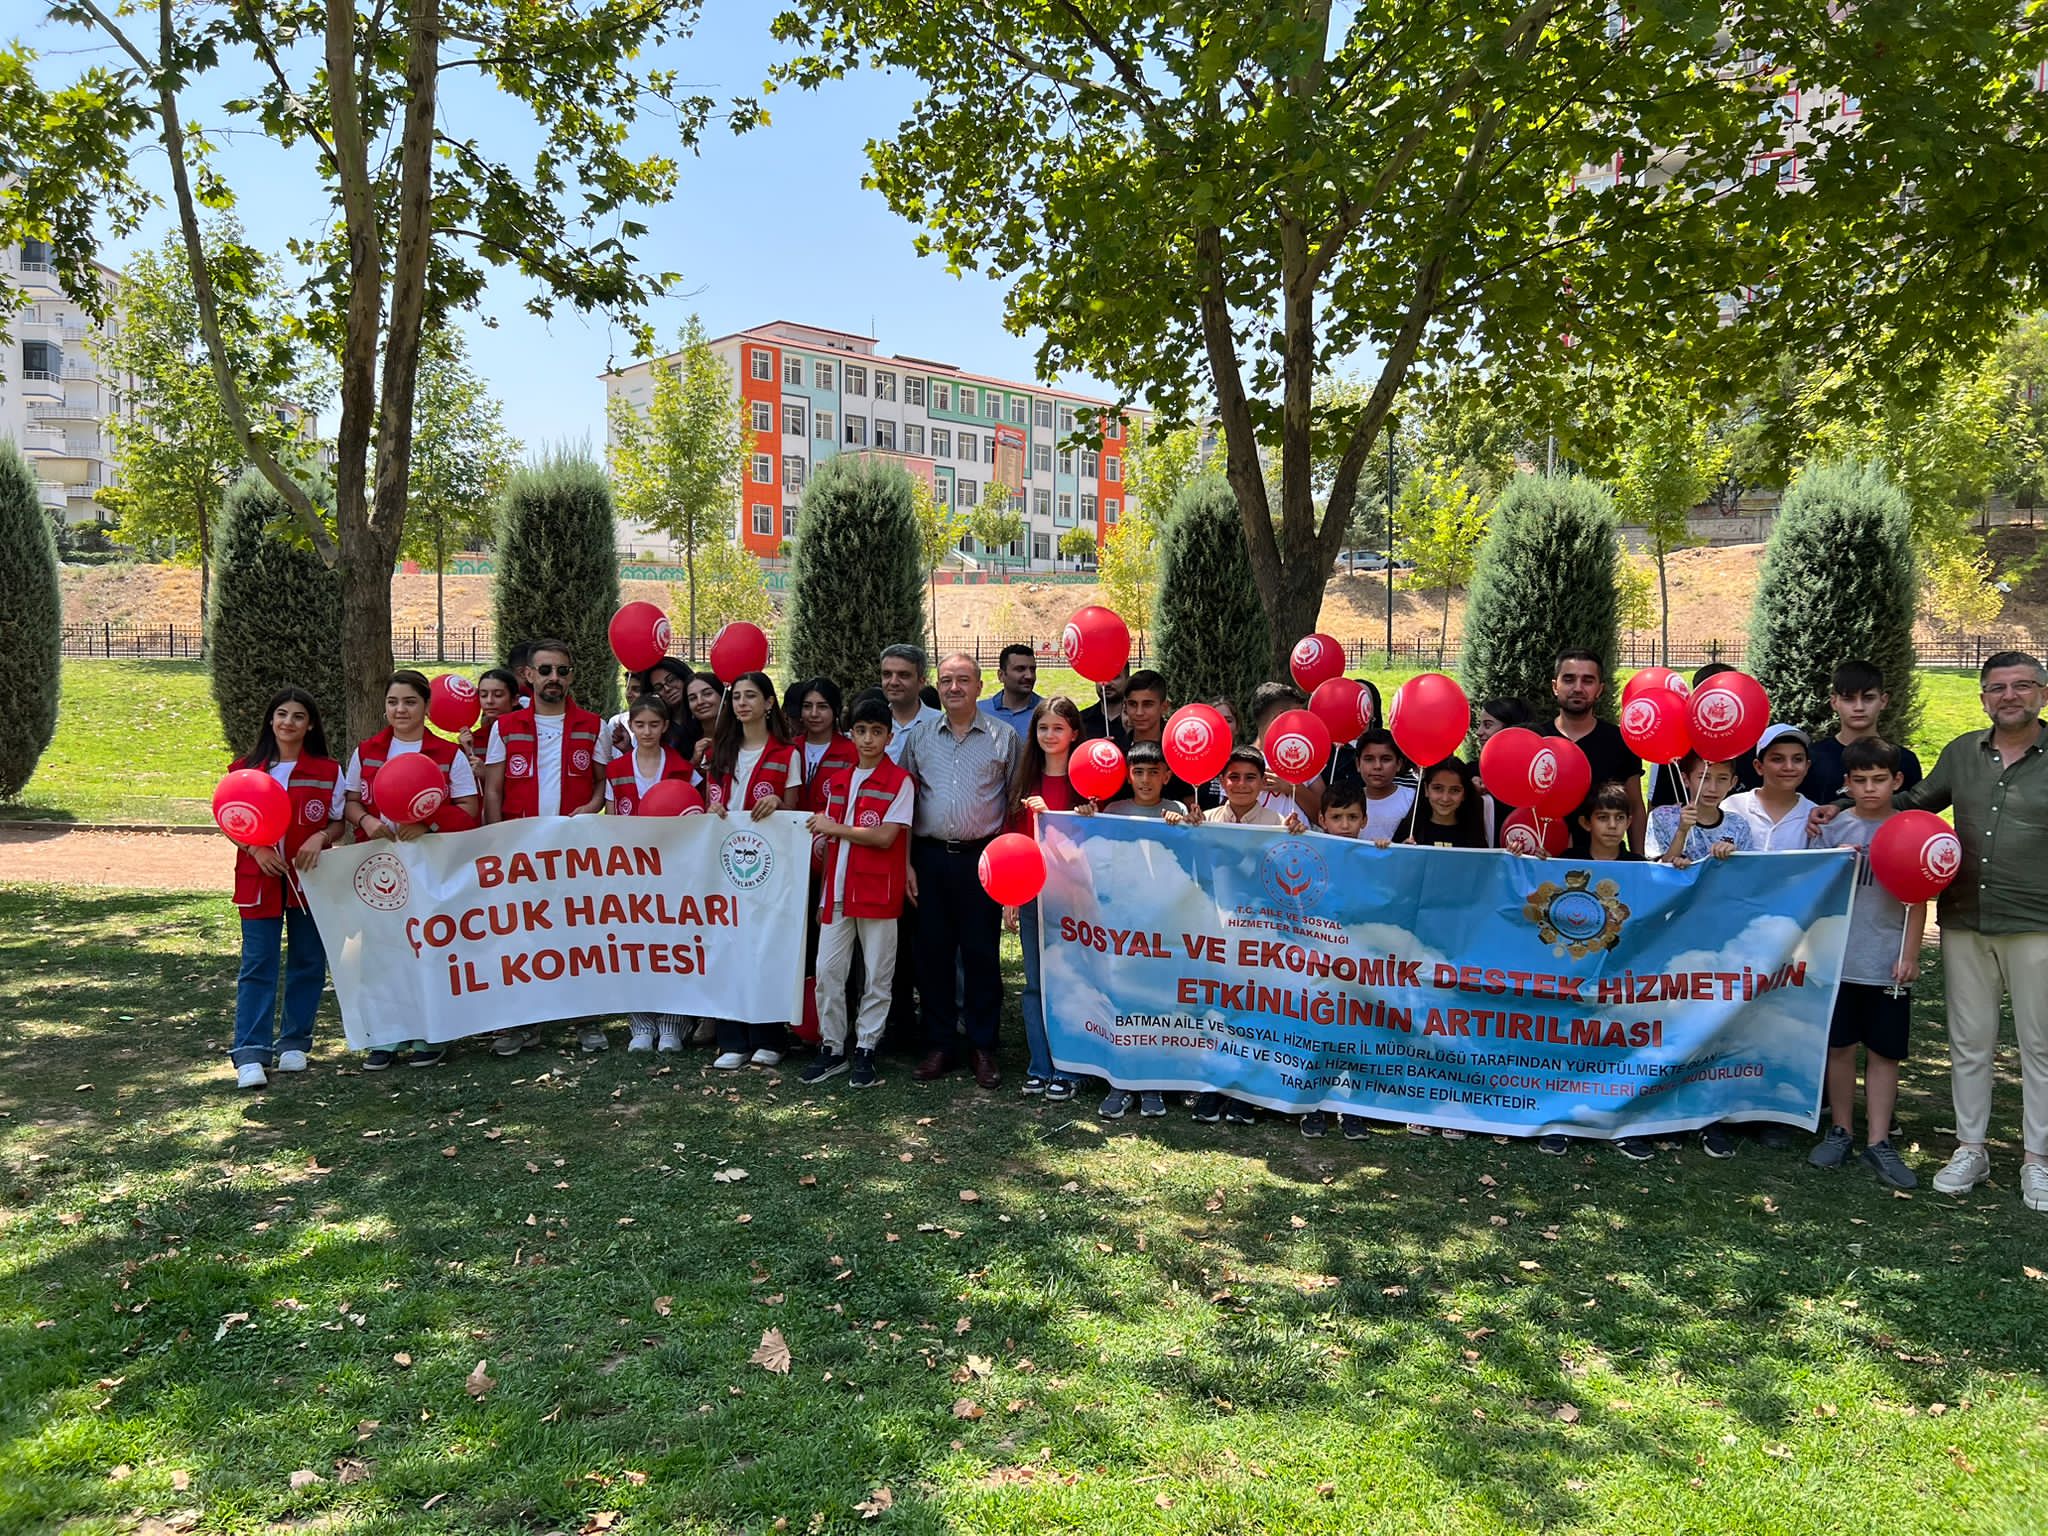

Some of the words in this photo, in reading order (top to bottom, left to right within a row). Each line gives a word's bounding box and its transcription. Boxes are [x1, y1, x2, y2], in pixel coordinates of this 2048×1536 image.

[475, 845, 663, 889] BATMAN
[405, 899, 553, 959] ÇOCUK
[564, 893, 738, 928] HAKLARI
[1236, 905, 1257, 915] T.C.
[1259, 906, 1283, 918] AİLE
[1286, 912, 1299, 922] VE
[1302, 915, 1343, 930] SOSYAL
[1292, 925, 1349, 945] BAKANLIĞI
[447, 953, 490, 997] İL
[501, 932, 706, 986] KOMİTESİ
[1060, 916, 1172, 959] SOSYAL
[1182, 933, 1227, 965] VE
[1237, 939, 1423, 988] EKONOMİK
[1433, 963, 1585, 1003] DESTEK
[1598, 961, 1807, 1005] HİZMETİNİN
[1177, 977, 1412, 1034] ETKİNLİĞİNİN
[1423, 1007, 1663, 1049] ARTIRILMASI
[1085, 1020, 1109, 1041] OKUL
[1162, 1035, 1219, 1051] PROJESİ
[1220, 1039, 1250, 1059] AİLE
[1252, 1047, 1271, 1062] VE
[1273, 1051, 1322, 1072] SOSYAL
[1325, 1058, 1404, 1077] HİZMETLER
[1407, 1065, 1486, 1087] BAKANLIĞI
[1489, 1074, 1541, 1090] ÇOCUK
[1545, 1077, 1636, 1097] HİZMETLERİ
[1115, 1015, 1171, 1028] BATMAN
[1174, 1014, 1204, 1031] AİLE
[1208, 1019, 1229, 1033] VE
[1228, 1025, 1281, 1043] SOSYAL
[1283, 1031, 1357, 1057] HİZMETLER
[1360, 1039, 1373, 1056] İL
[1375, 1040, 1466, 1066] MÜDÜRLÜĞÜ
[1471, 1053, 1562, 1072] TARAFINDAN
[1566, 1058, 1686, 1078] YÜRÜTÜLMEKTE
[1280, 1072, 1361, 1091] TARAFINDAN
[1365, 1079, 1425, 1099] FİNANSE
[1430, 1086, 1540, 1111] EDİLMEKTEDİR.
